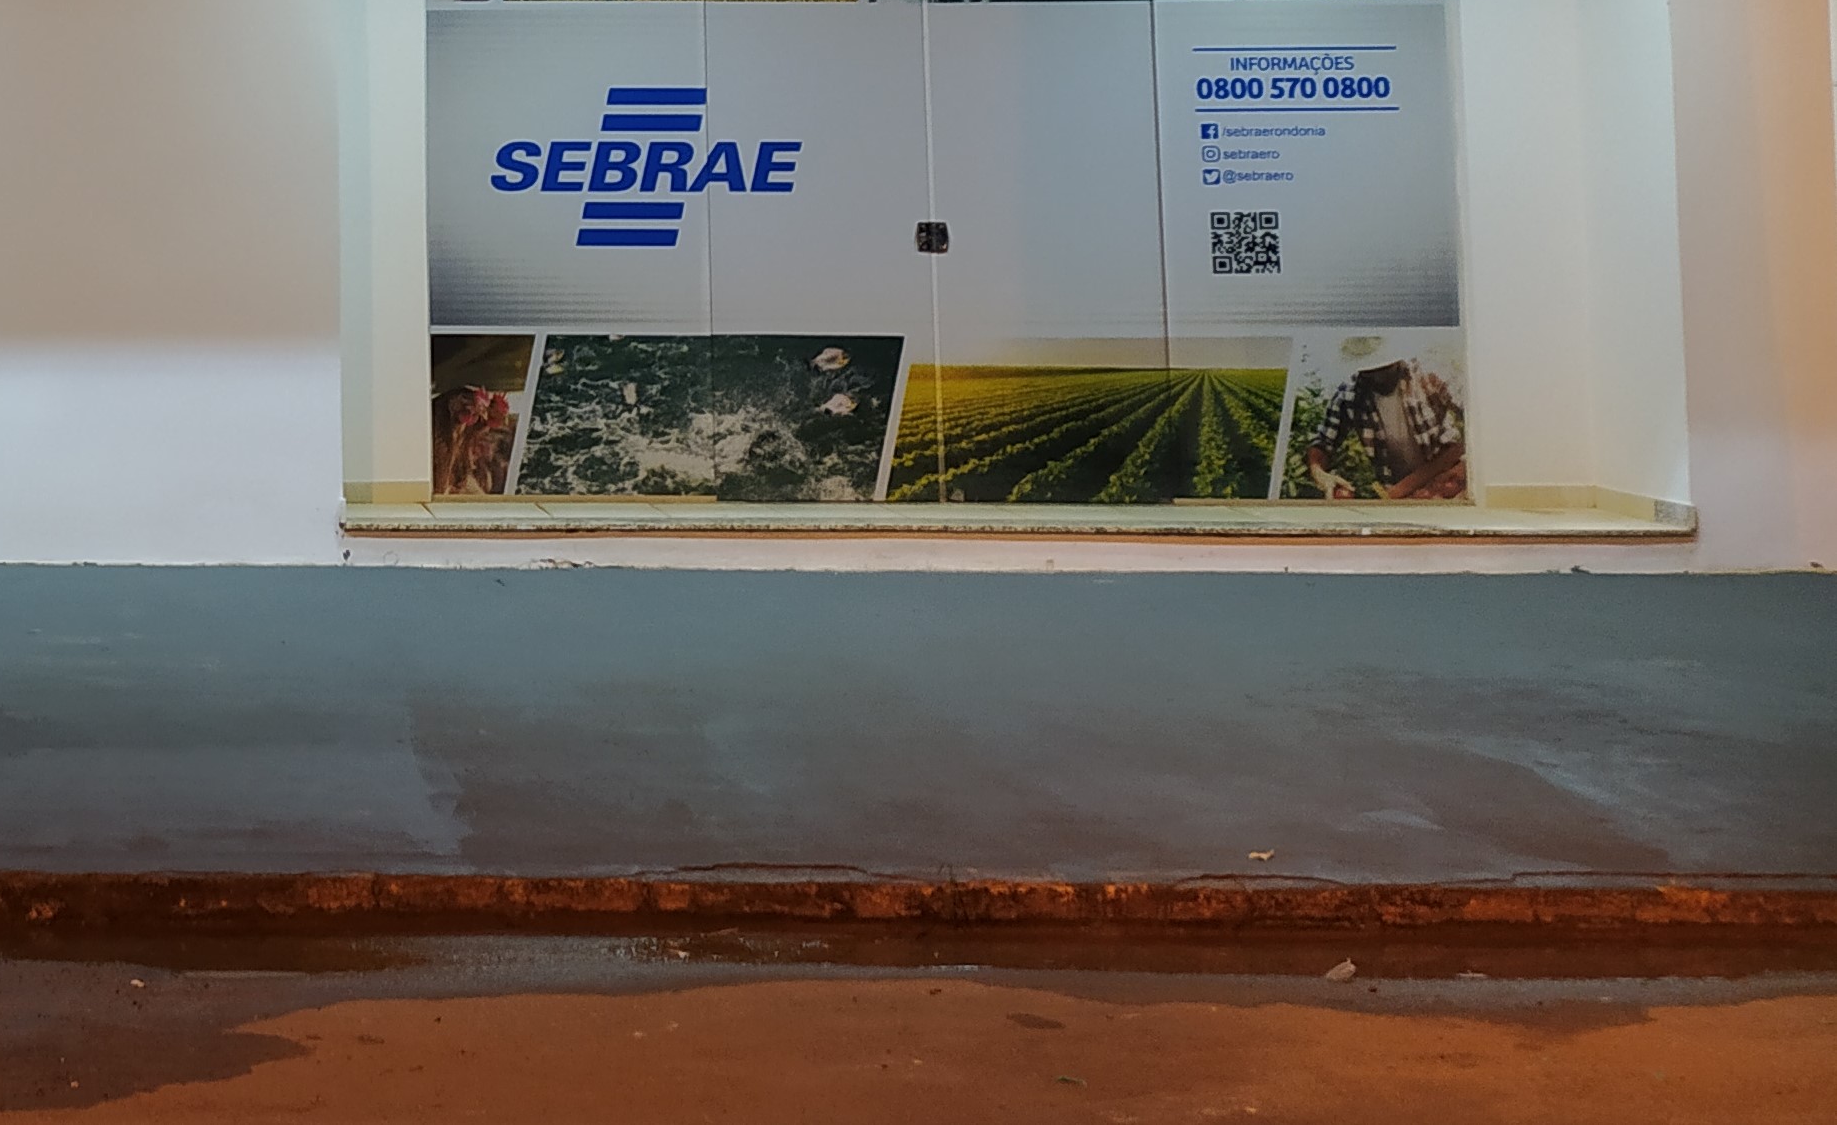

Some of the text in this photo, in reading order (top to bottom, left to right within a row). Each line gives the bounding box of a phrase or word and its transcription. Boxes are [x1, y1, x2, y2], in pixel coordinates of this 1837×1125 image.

[1229, 53, 1355, 75] INFORMAÇÕES
[1196, 76, 1391, 100] 0800 570 0800
[1222, 125, 1326, 138] /sebraerondonia
[1222, 148, 1280, 160] sebraero
[490, 140, 803, 193] SEBRAE
[1222, 169, 1294, 184] @sebraero
